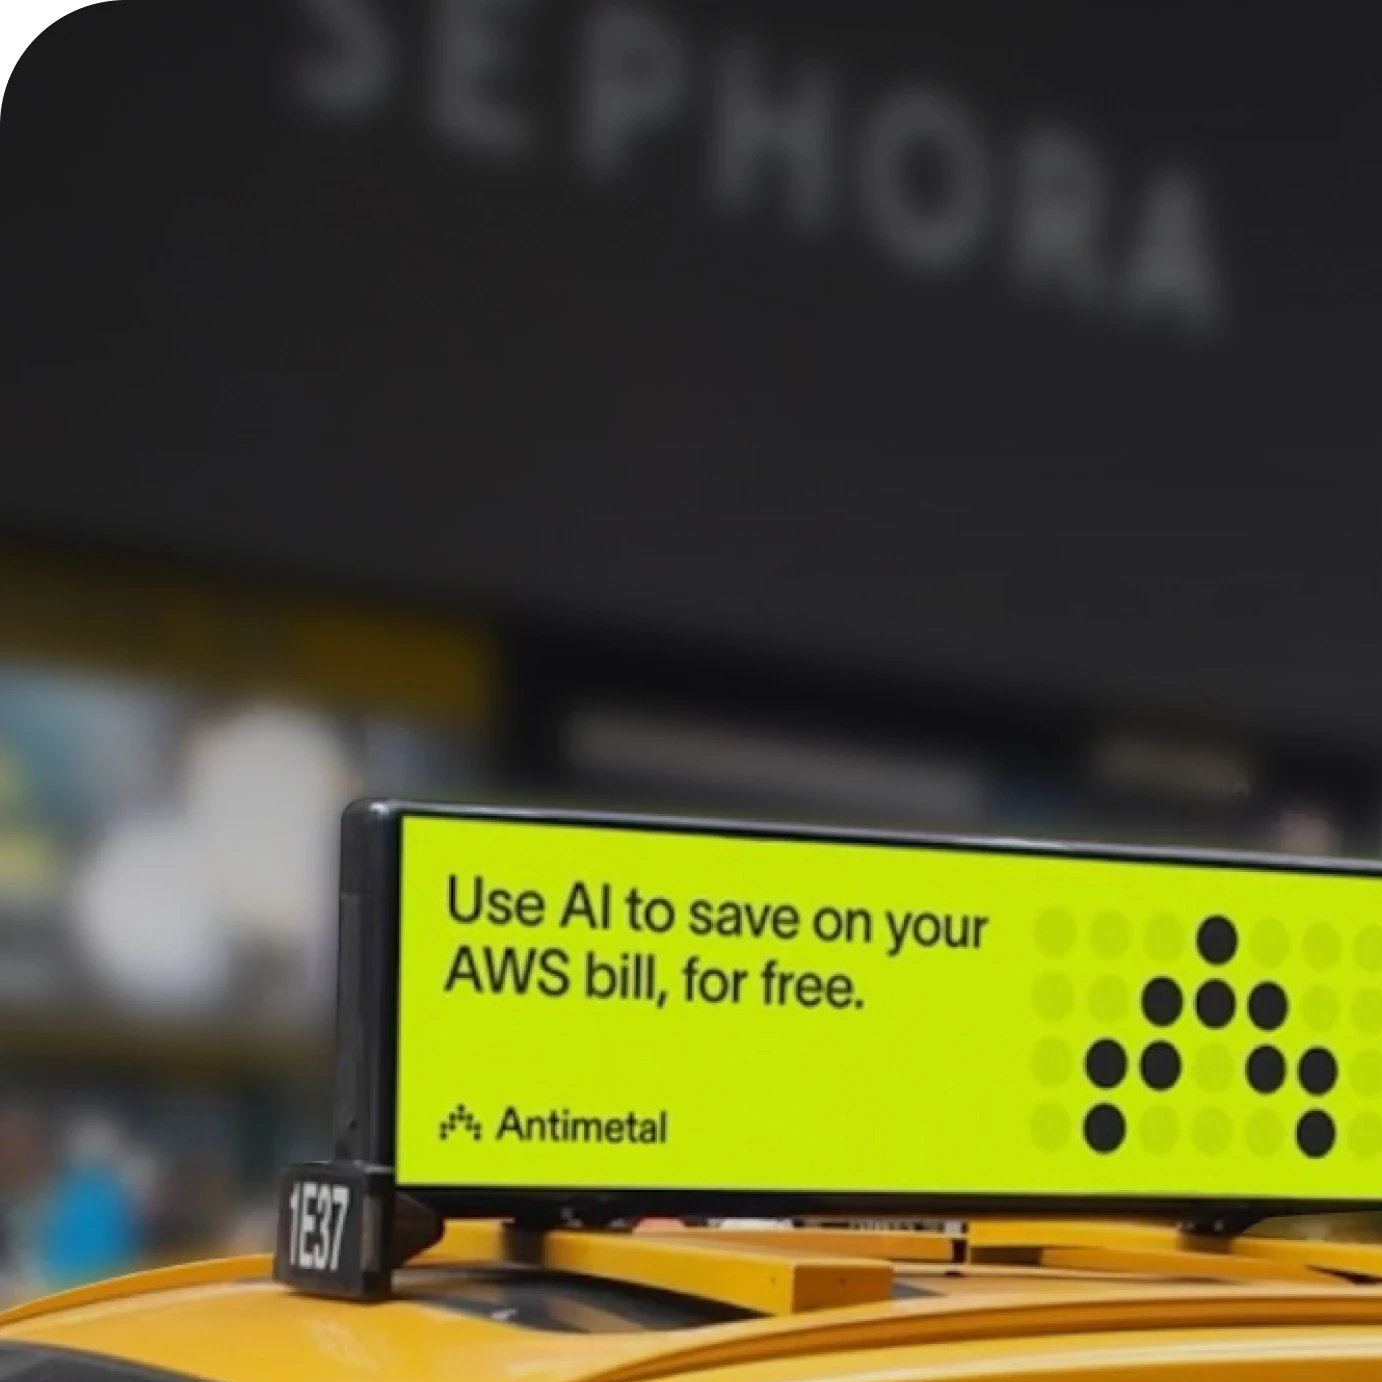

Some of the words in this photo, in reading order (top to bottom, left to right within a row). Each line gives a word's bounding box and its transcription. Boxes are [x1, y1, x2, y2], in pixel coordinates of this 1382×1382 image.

[290, 0, 1220, 336] SEPHORA
[447, 874, 545, 926] Use
[560, 880, 611, 930] AI
[626, 887, 675, 933] to
[689, 899, 800, 940] save
[813, 906, 872, 943] on
[886, 911, 989, 957] your
[444, 945, 571, 998] AWS
[586, 951, 668, 1009] bill,
[683, 955, 748, 1004] for
[761, 959, 865, 1010] free.
[497, 1106, 667, 1144] Antimetal
[288, 1181, 350, 1272] 1E37
